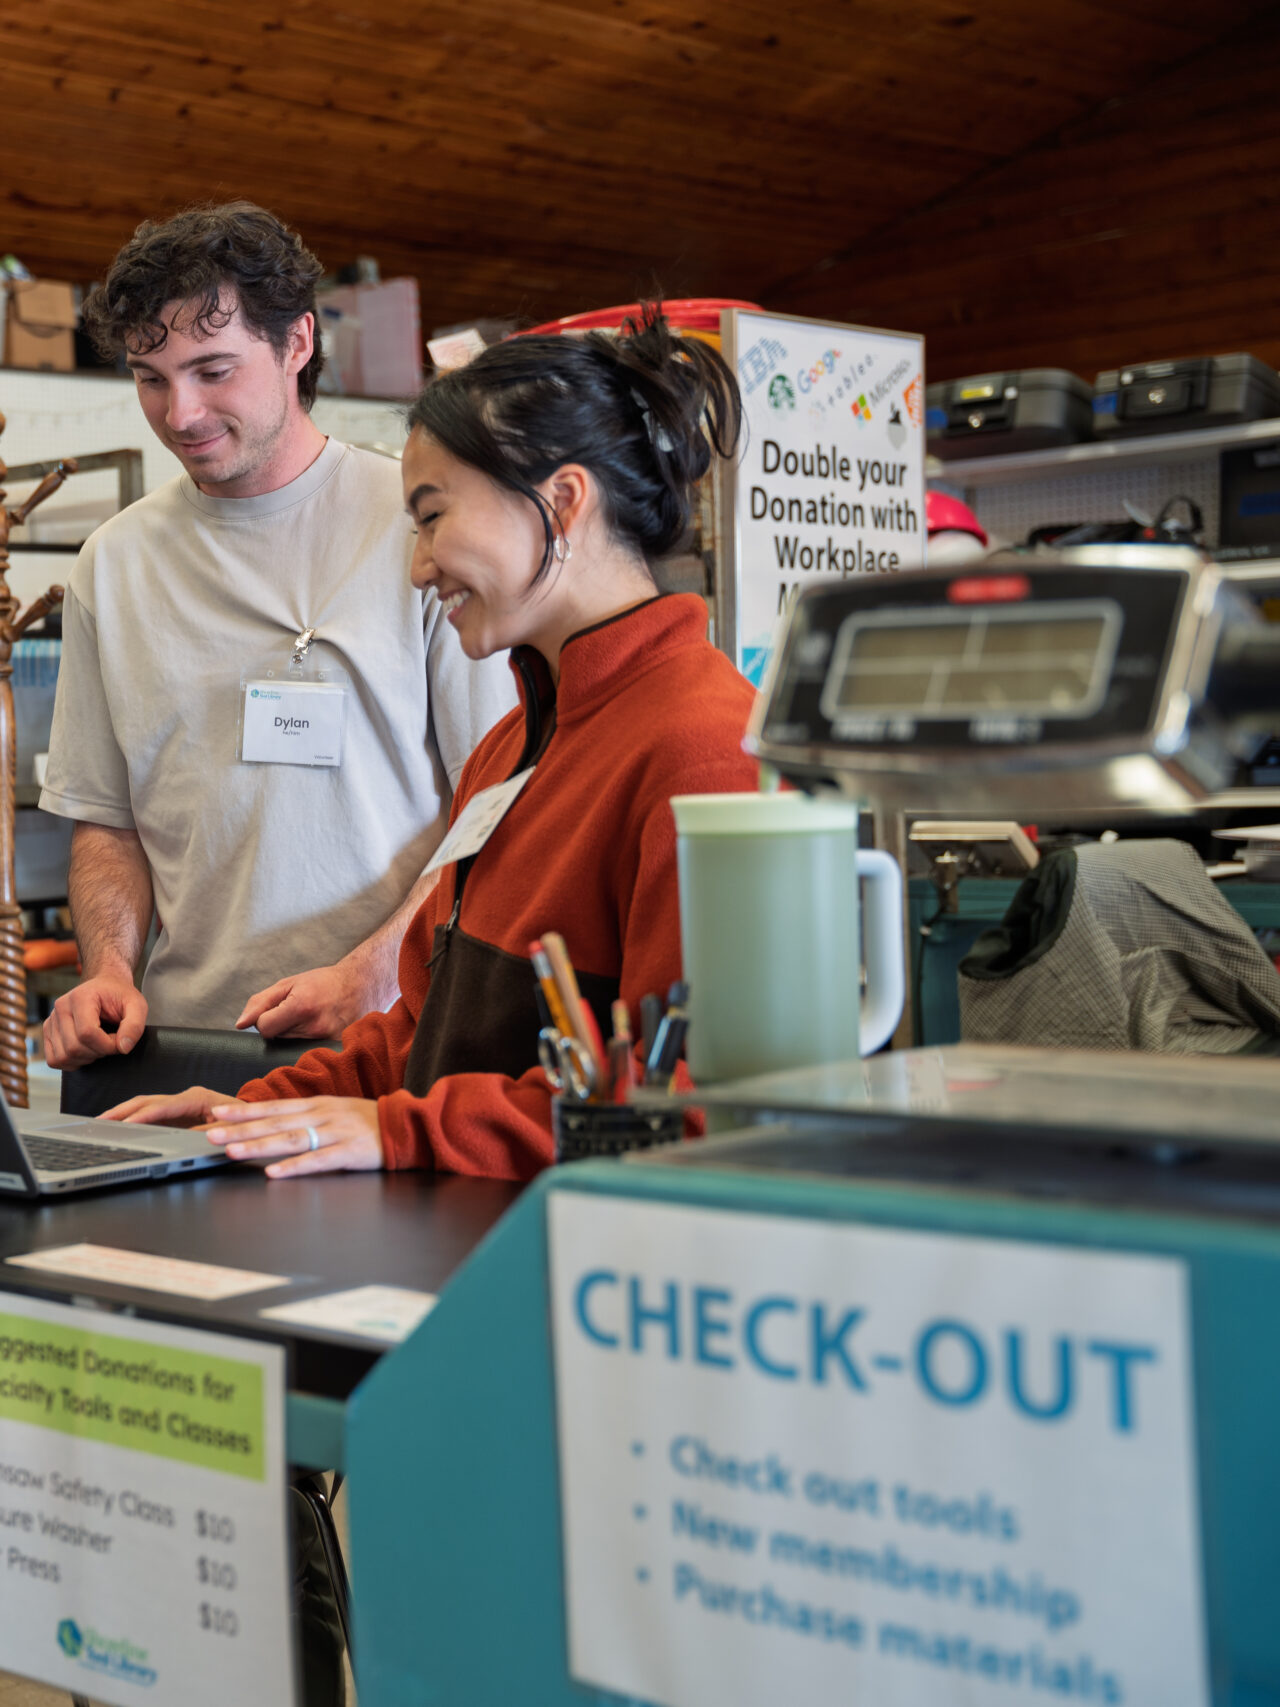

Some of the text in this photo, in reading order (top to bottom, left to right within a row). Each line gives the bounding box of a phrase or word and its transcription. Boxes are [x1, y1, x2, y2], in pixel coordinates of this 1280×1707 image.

[762, 439, 908, 492] Double your
[751, 486, 918, 533] Donation with
[774, 534, 900, 580] Workplace
[274, 716, 310, 731] Dylan
[83, 1349, 196, 1395] Donations
[202, 1372, 236, 1402] for
[574, 1268, 1159, 1435] CHECK-OUT
[60, 1386, 113, 1422] Tools
[119, 1406, 161, 1433] and
[166, 1412, 253, 1455] Classes
[49, 1471, 114, 1516] Safety
[119, 1490, 175, 1529] Class
[194, 1508, 236, 1544] $10
[668, 1435, 1022, 1543] Check out tools
[37, 1511, 113, 1553] Washer
[7, 1547, 62, 1583] Press
[196, 1555, 238, 1592] $10
[670, 1499, 1082, 1633] New membership
[198, 1601, 240, 1638] $10
[673, 1561, 1124, 1707] Purchase materials
